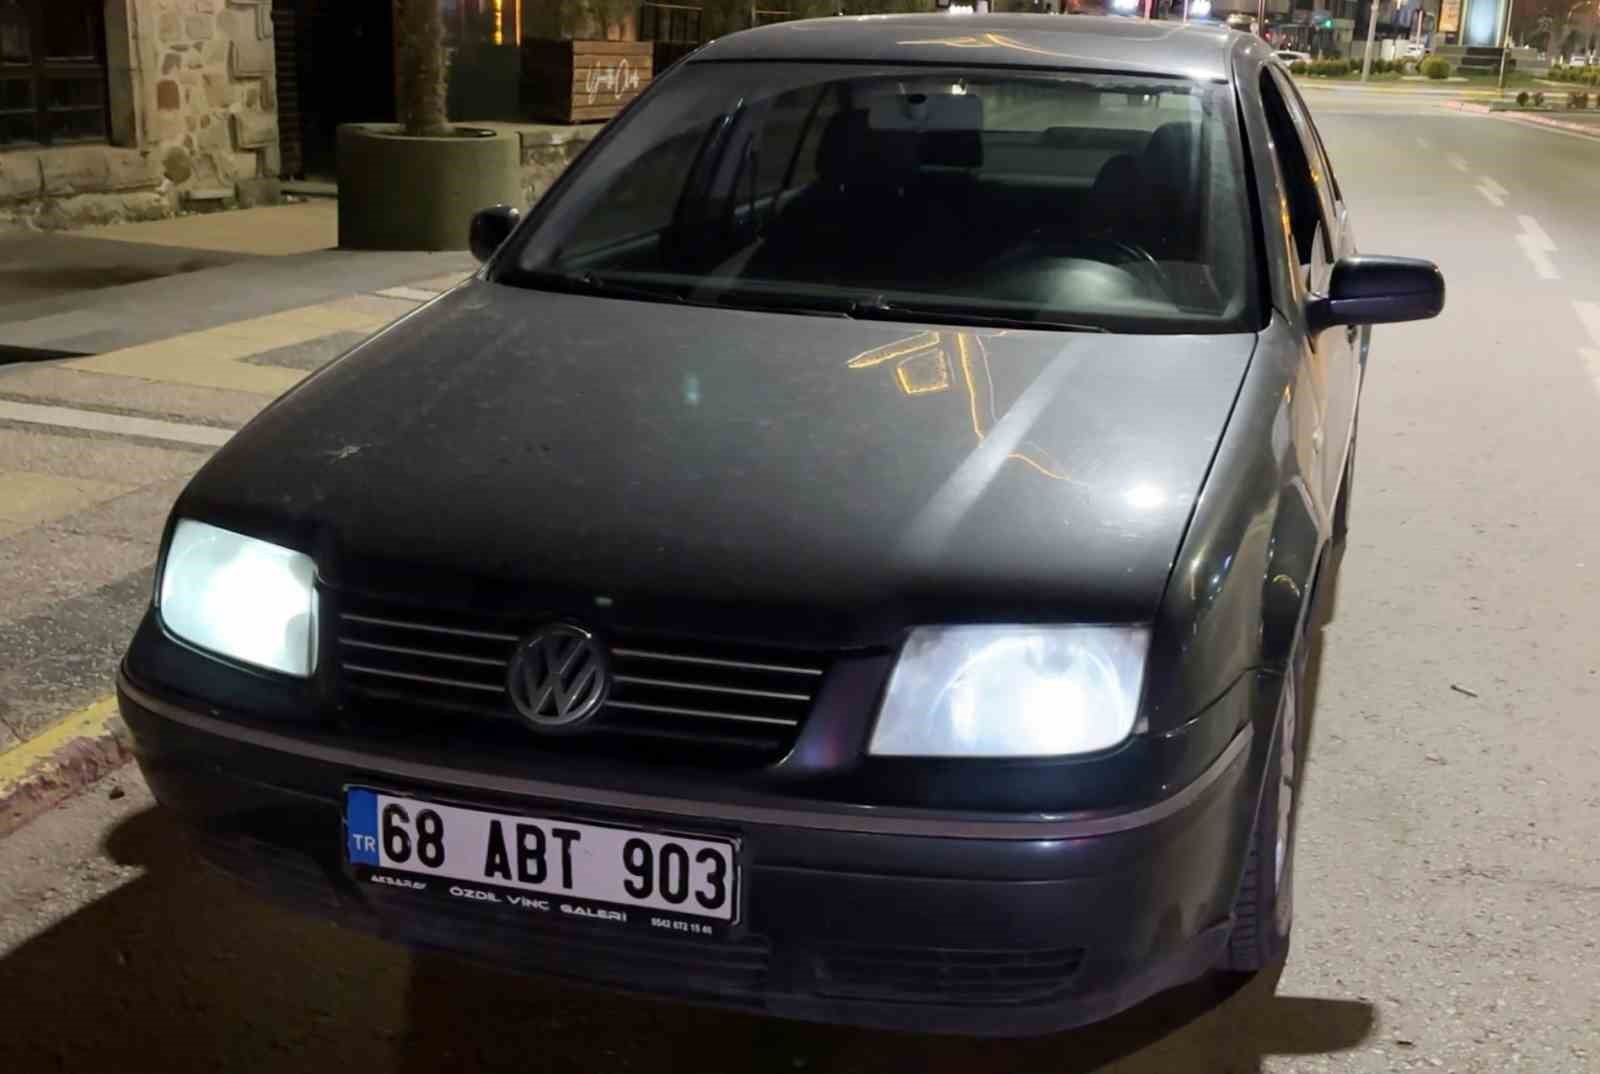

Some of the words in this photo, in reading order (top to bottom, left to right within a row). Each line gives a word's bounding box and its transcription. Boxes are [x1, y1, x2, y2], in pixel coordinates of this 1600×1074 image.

[352, 833, 377, 853] TR
[382, 803, 446, 869] 68
[484, 819, 582, 890] ABT
[623, 838, 726, 910] 903
